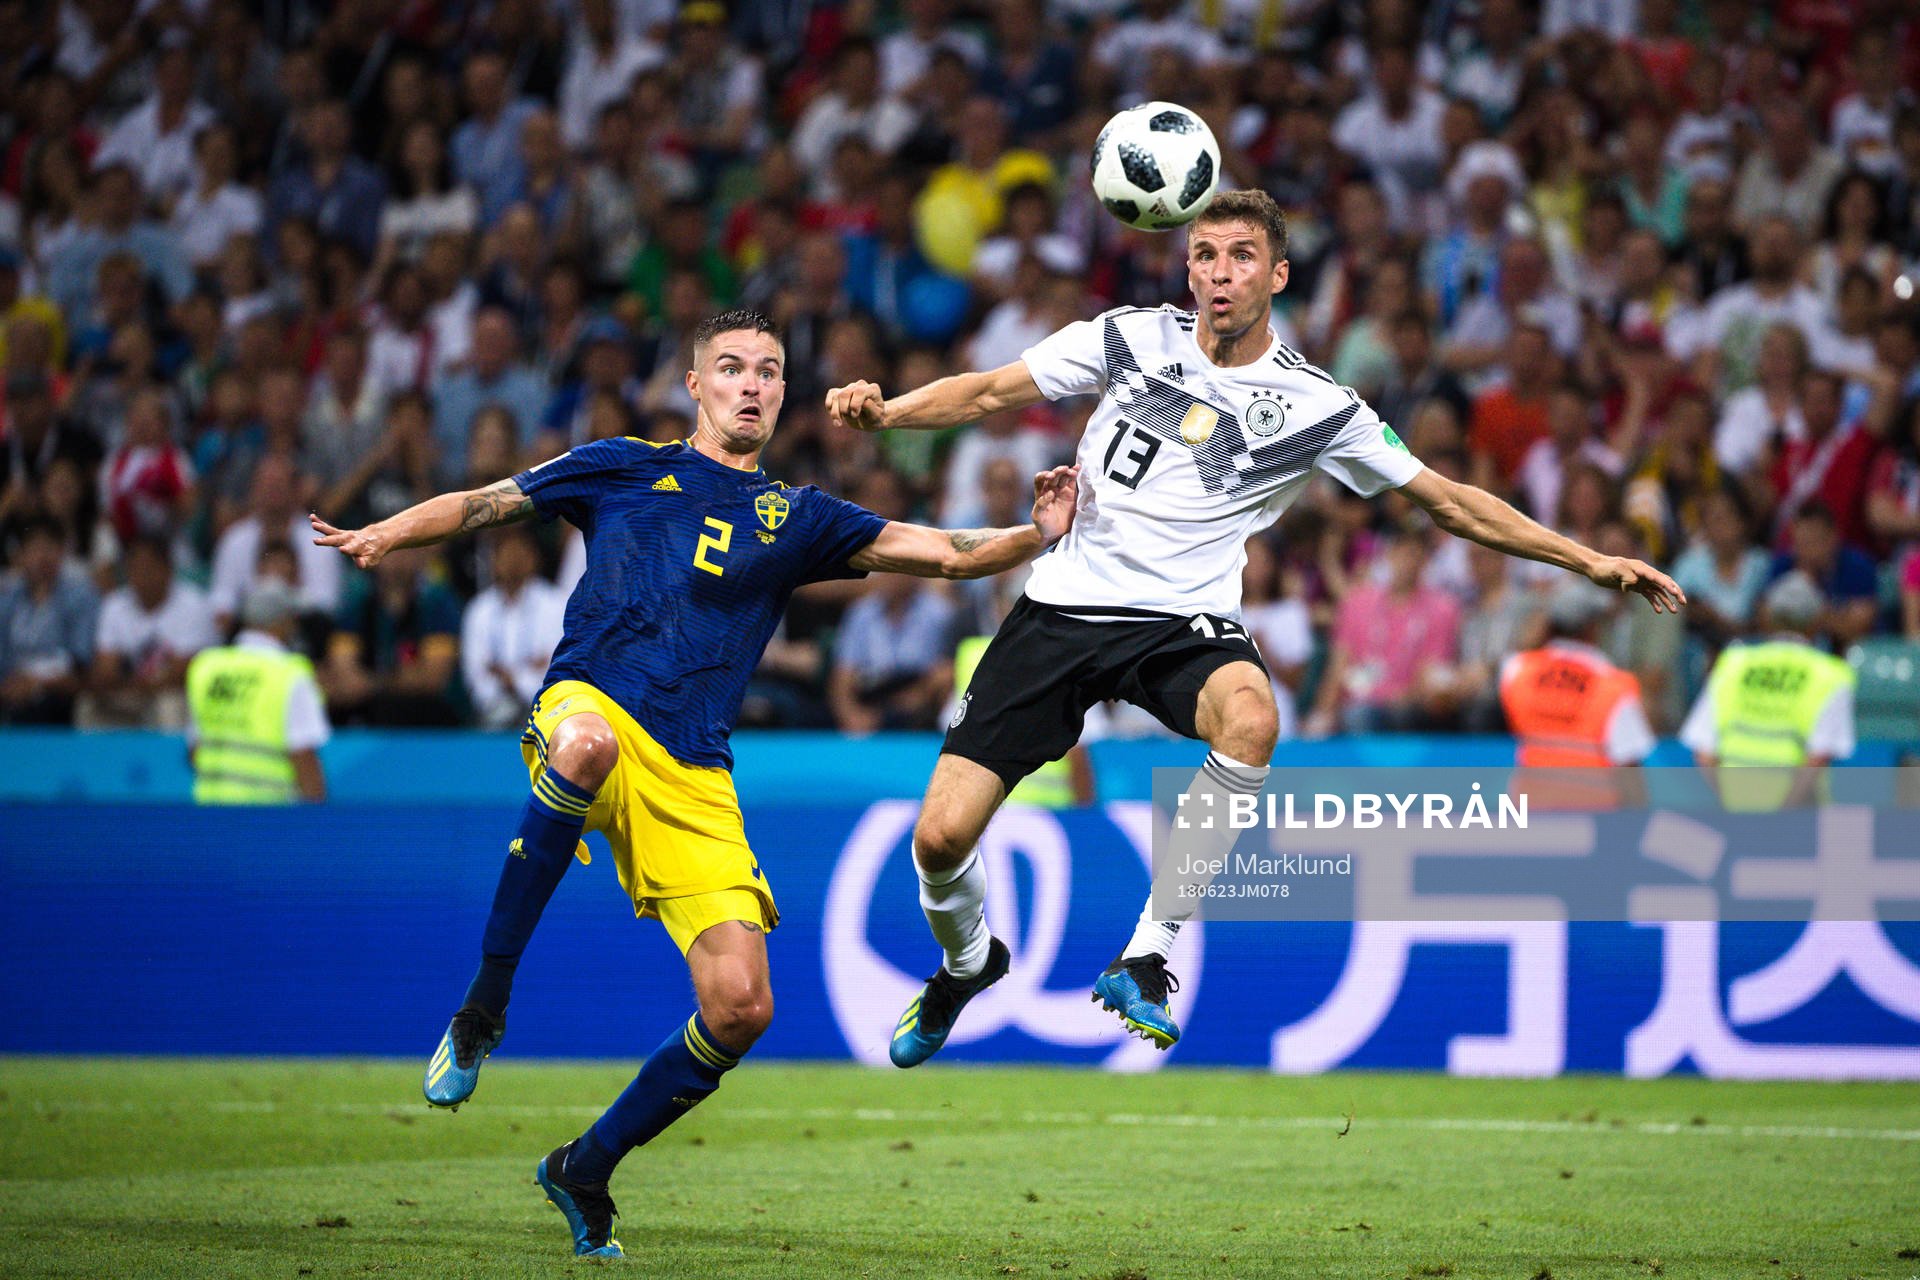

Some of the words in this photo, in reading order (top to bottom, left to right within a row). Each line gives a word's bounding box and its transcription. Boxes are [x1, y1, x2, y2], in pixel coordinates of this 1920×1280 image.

[1156, 369, 1186, 386] adidas
[1103, 418, 1163, 491] 13
[693, 515, 734, 577] 2
